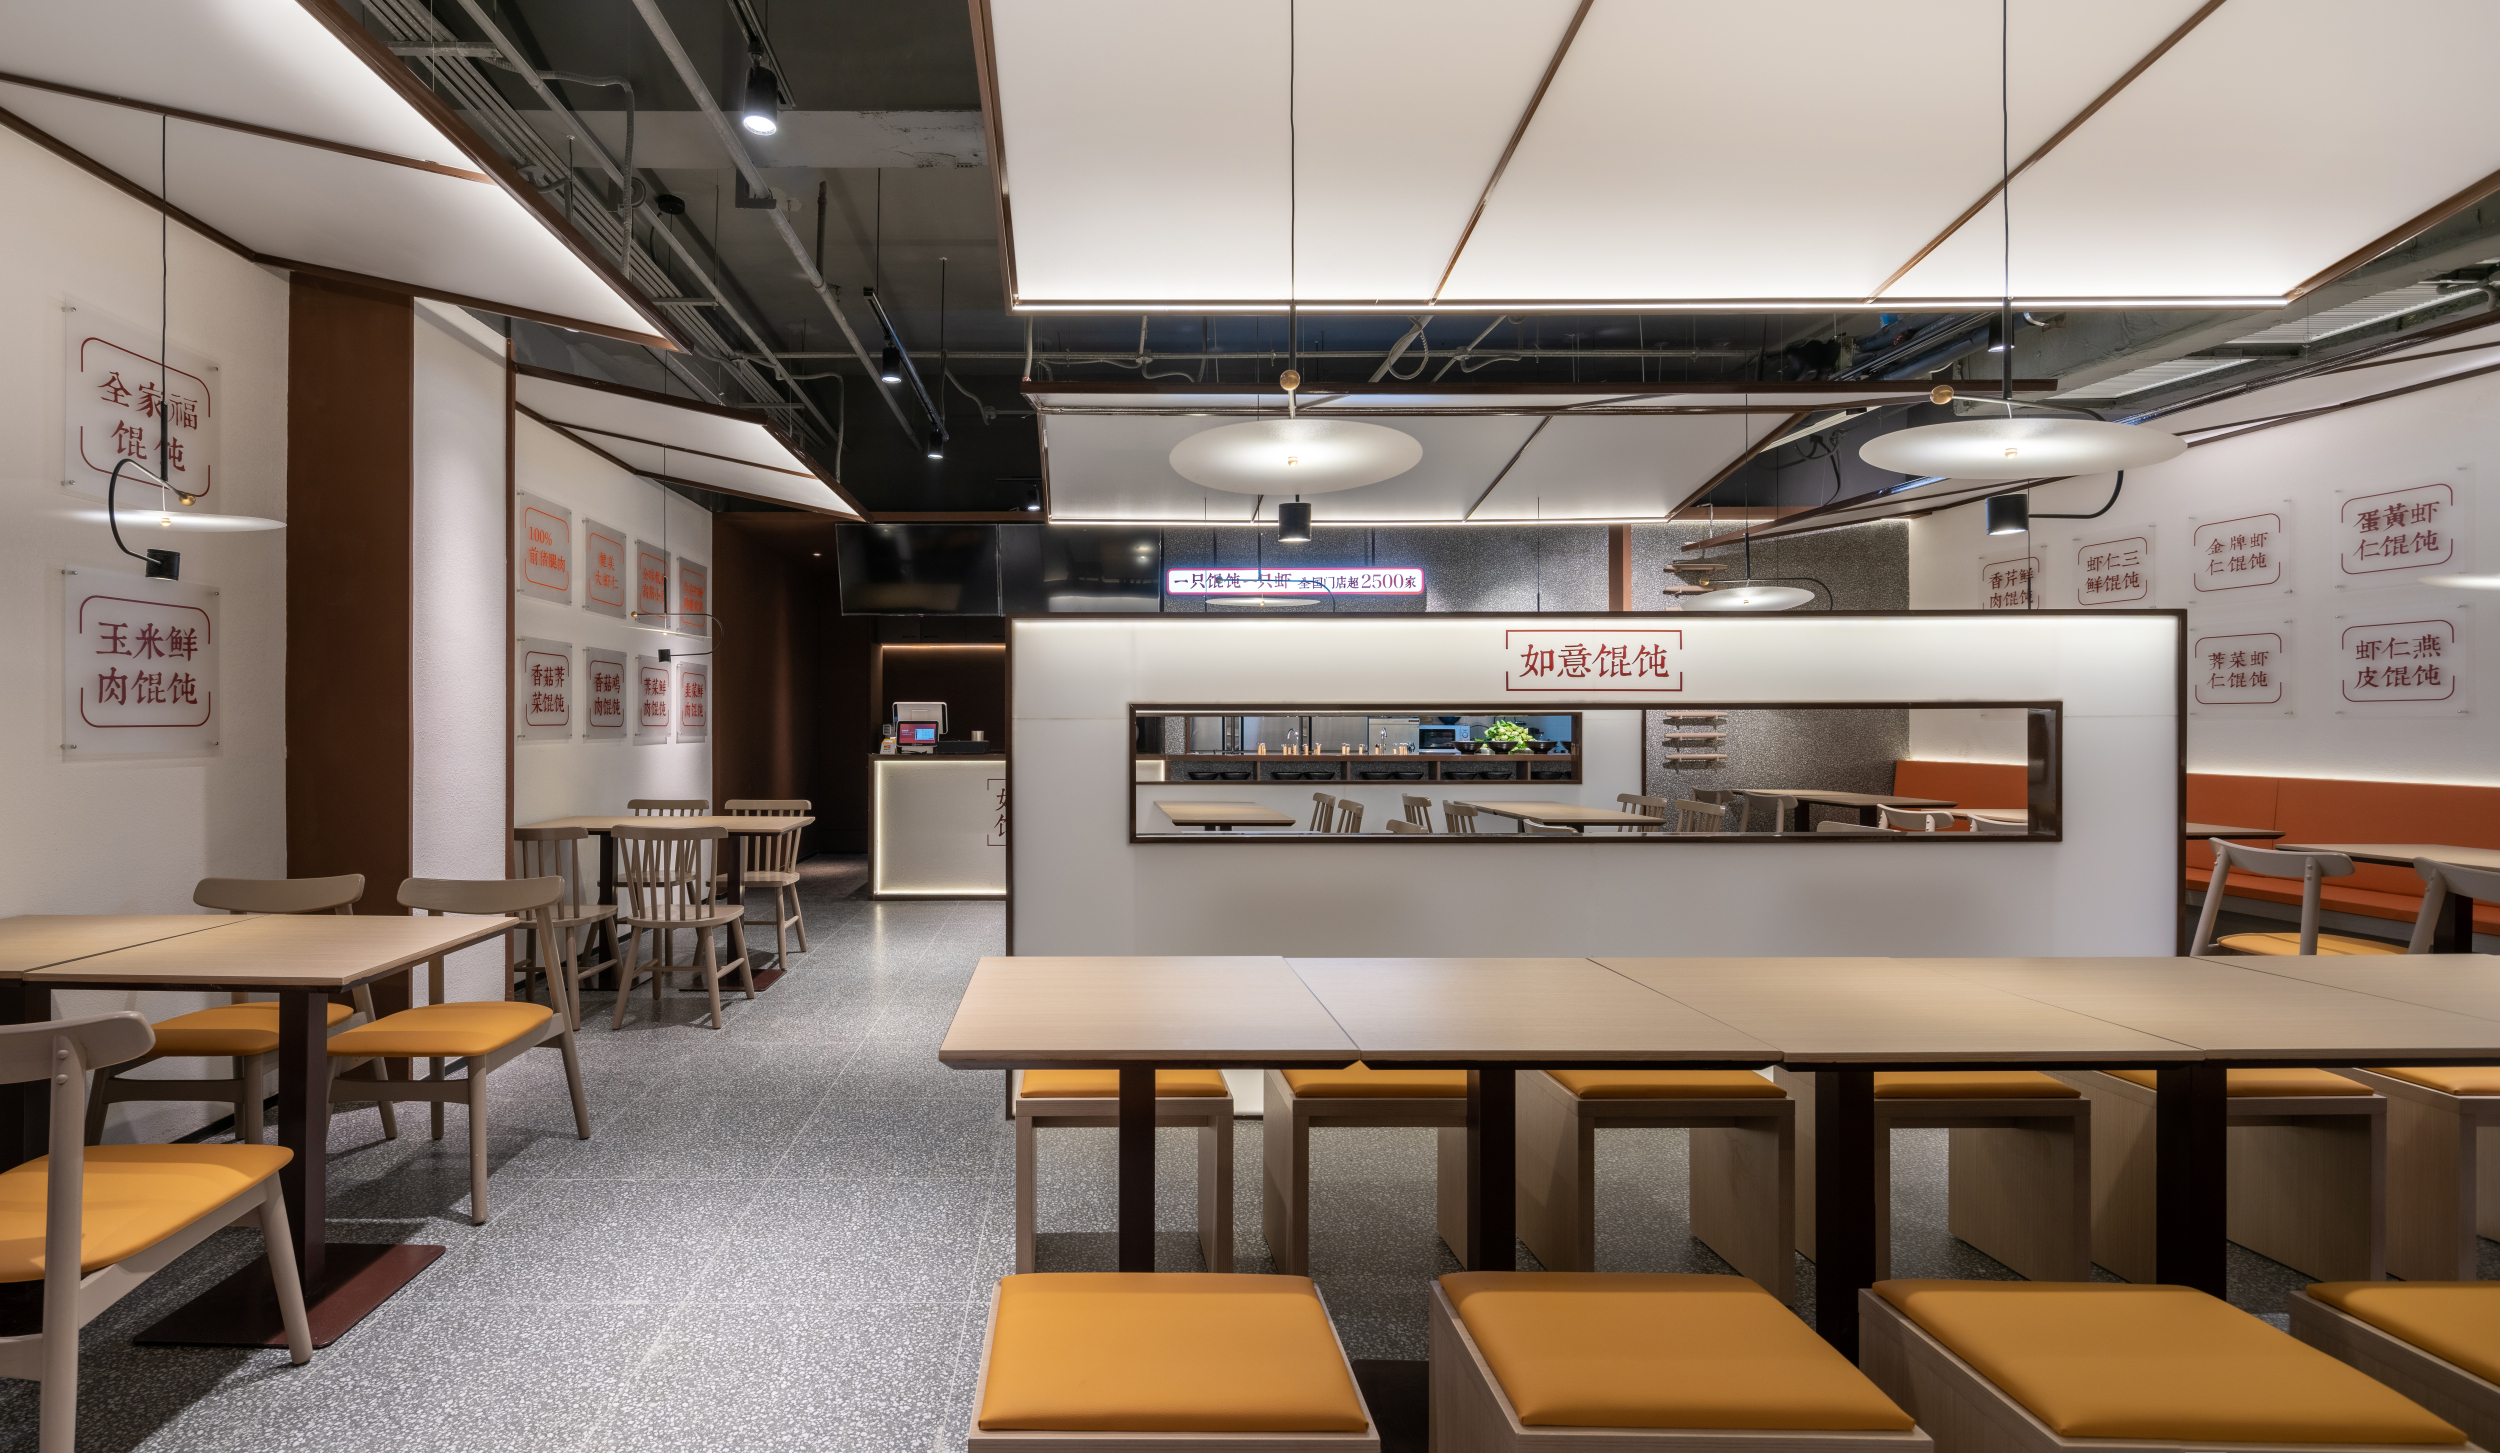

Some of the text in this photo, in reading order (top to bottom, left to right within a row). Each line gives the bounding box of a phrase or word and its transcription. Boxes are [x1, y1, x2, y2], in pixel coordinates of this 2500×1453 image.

[529, 526, 553, 546] 100%
[2205, 532, 2268, 556] 金牌虾
[2353, 530, 2440, 561] 仁馄饨
[2087, 550, 2140, 572] 虾仁三
[2205, 552, 2267, 576] 仁馄饨
[1297, 573, 1417, 590] 全国门店超2500家
[2085, 571, 2140, 594] 鲜馄饨
[96, 621, 199, 662] 玉米鲜
[2356, 634, 2441, 661] 虾仁燕
[1519, 643, 1670, 678] 如意馄饨
[98, 666, 199, 706] 肉馄饨
[2207, 670, 2269, 690] 仁馄饨
[2354, 664, 2441, 690] 皮馄饨
[531, 691, 565, 715] 菜馄饨
[594, 696, 621, 716] 肉馄饨
[643, 699, 667, 717] 肉馄饨
